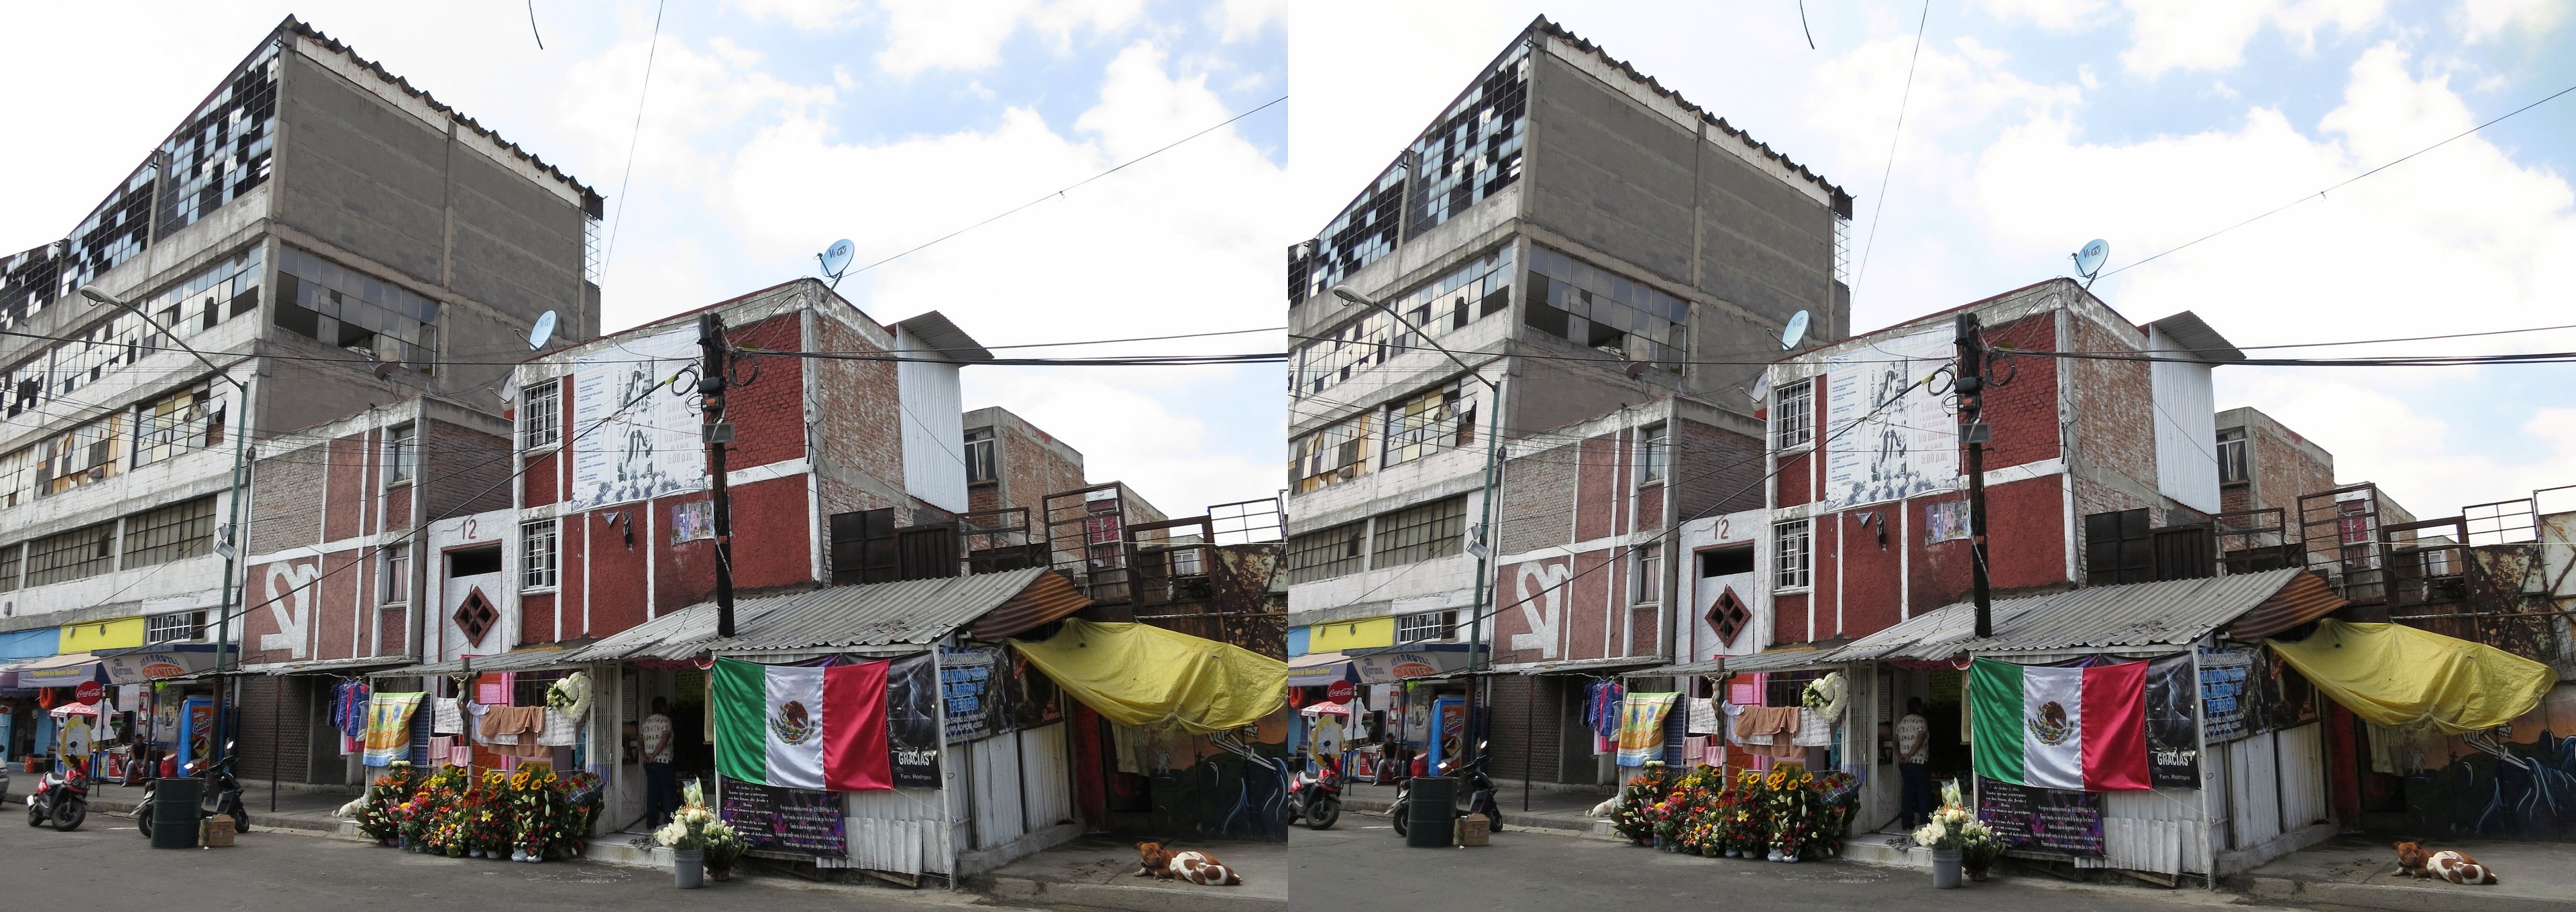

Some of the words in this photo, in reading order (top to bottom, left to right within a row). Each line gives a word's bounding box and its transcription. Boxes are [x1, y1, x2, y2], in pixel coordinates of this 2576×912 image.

[667, 453, 680, 465] 5:00
[1921, 453, 1935, 465] 5:00
[462, 519, 478, 540] 12
[1714, 518, 1729, 540] 12
[140, 654, 180, 667] ABARROTES
[1391, 654, 1431, 667] ABARROTES
[112, 665, 134, 677] Corona
[1362, 665, 1385, 677] Corona
[76, 689, 102, 698] Coca-Cola
[1329, 687, 1352, 697] Coca-Cola
[949, 697, 979, 712] TEPITO
[2207, 697, 2237, 714] TEPITO
[1444, 718, 1464, 734] Gansito
[898, 752, 930, 766] GRACIAS
[2157, 753, 2188, 766] GRACIAS
